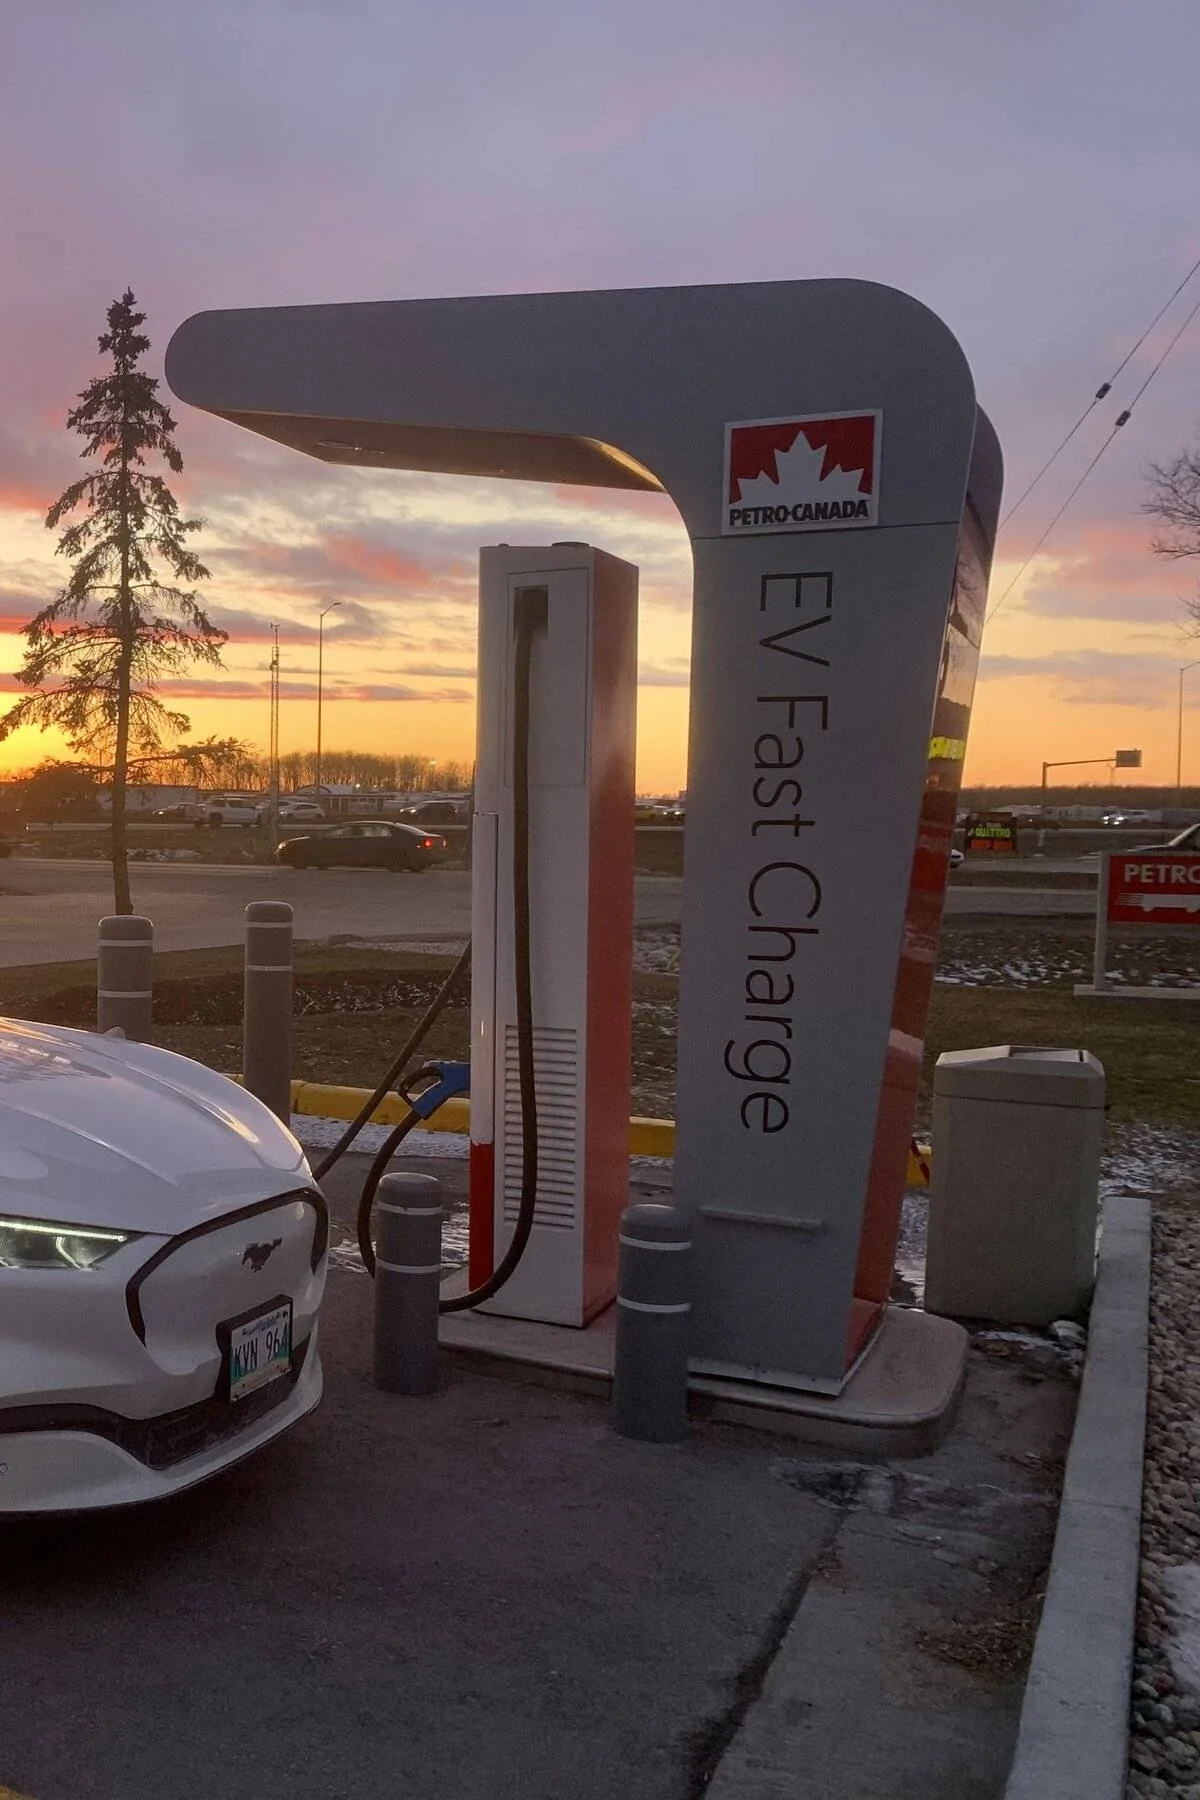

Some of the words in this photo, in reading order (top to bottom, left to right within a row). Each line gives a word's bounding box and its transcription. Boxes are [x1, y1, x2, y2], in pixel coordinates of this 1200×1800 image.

[759, 571, 833, 667] EV
[751, 695, 829, 837] Fast
[724, 860, 823, 1134] Charge
